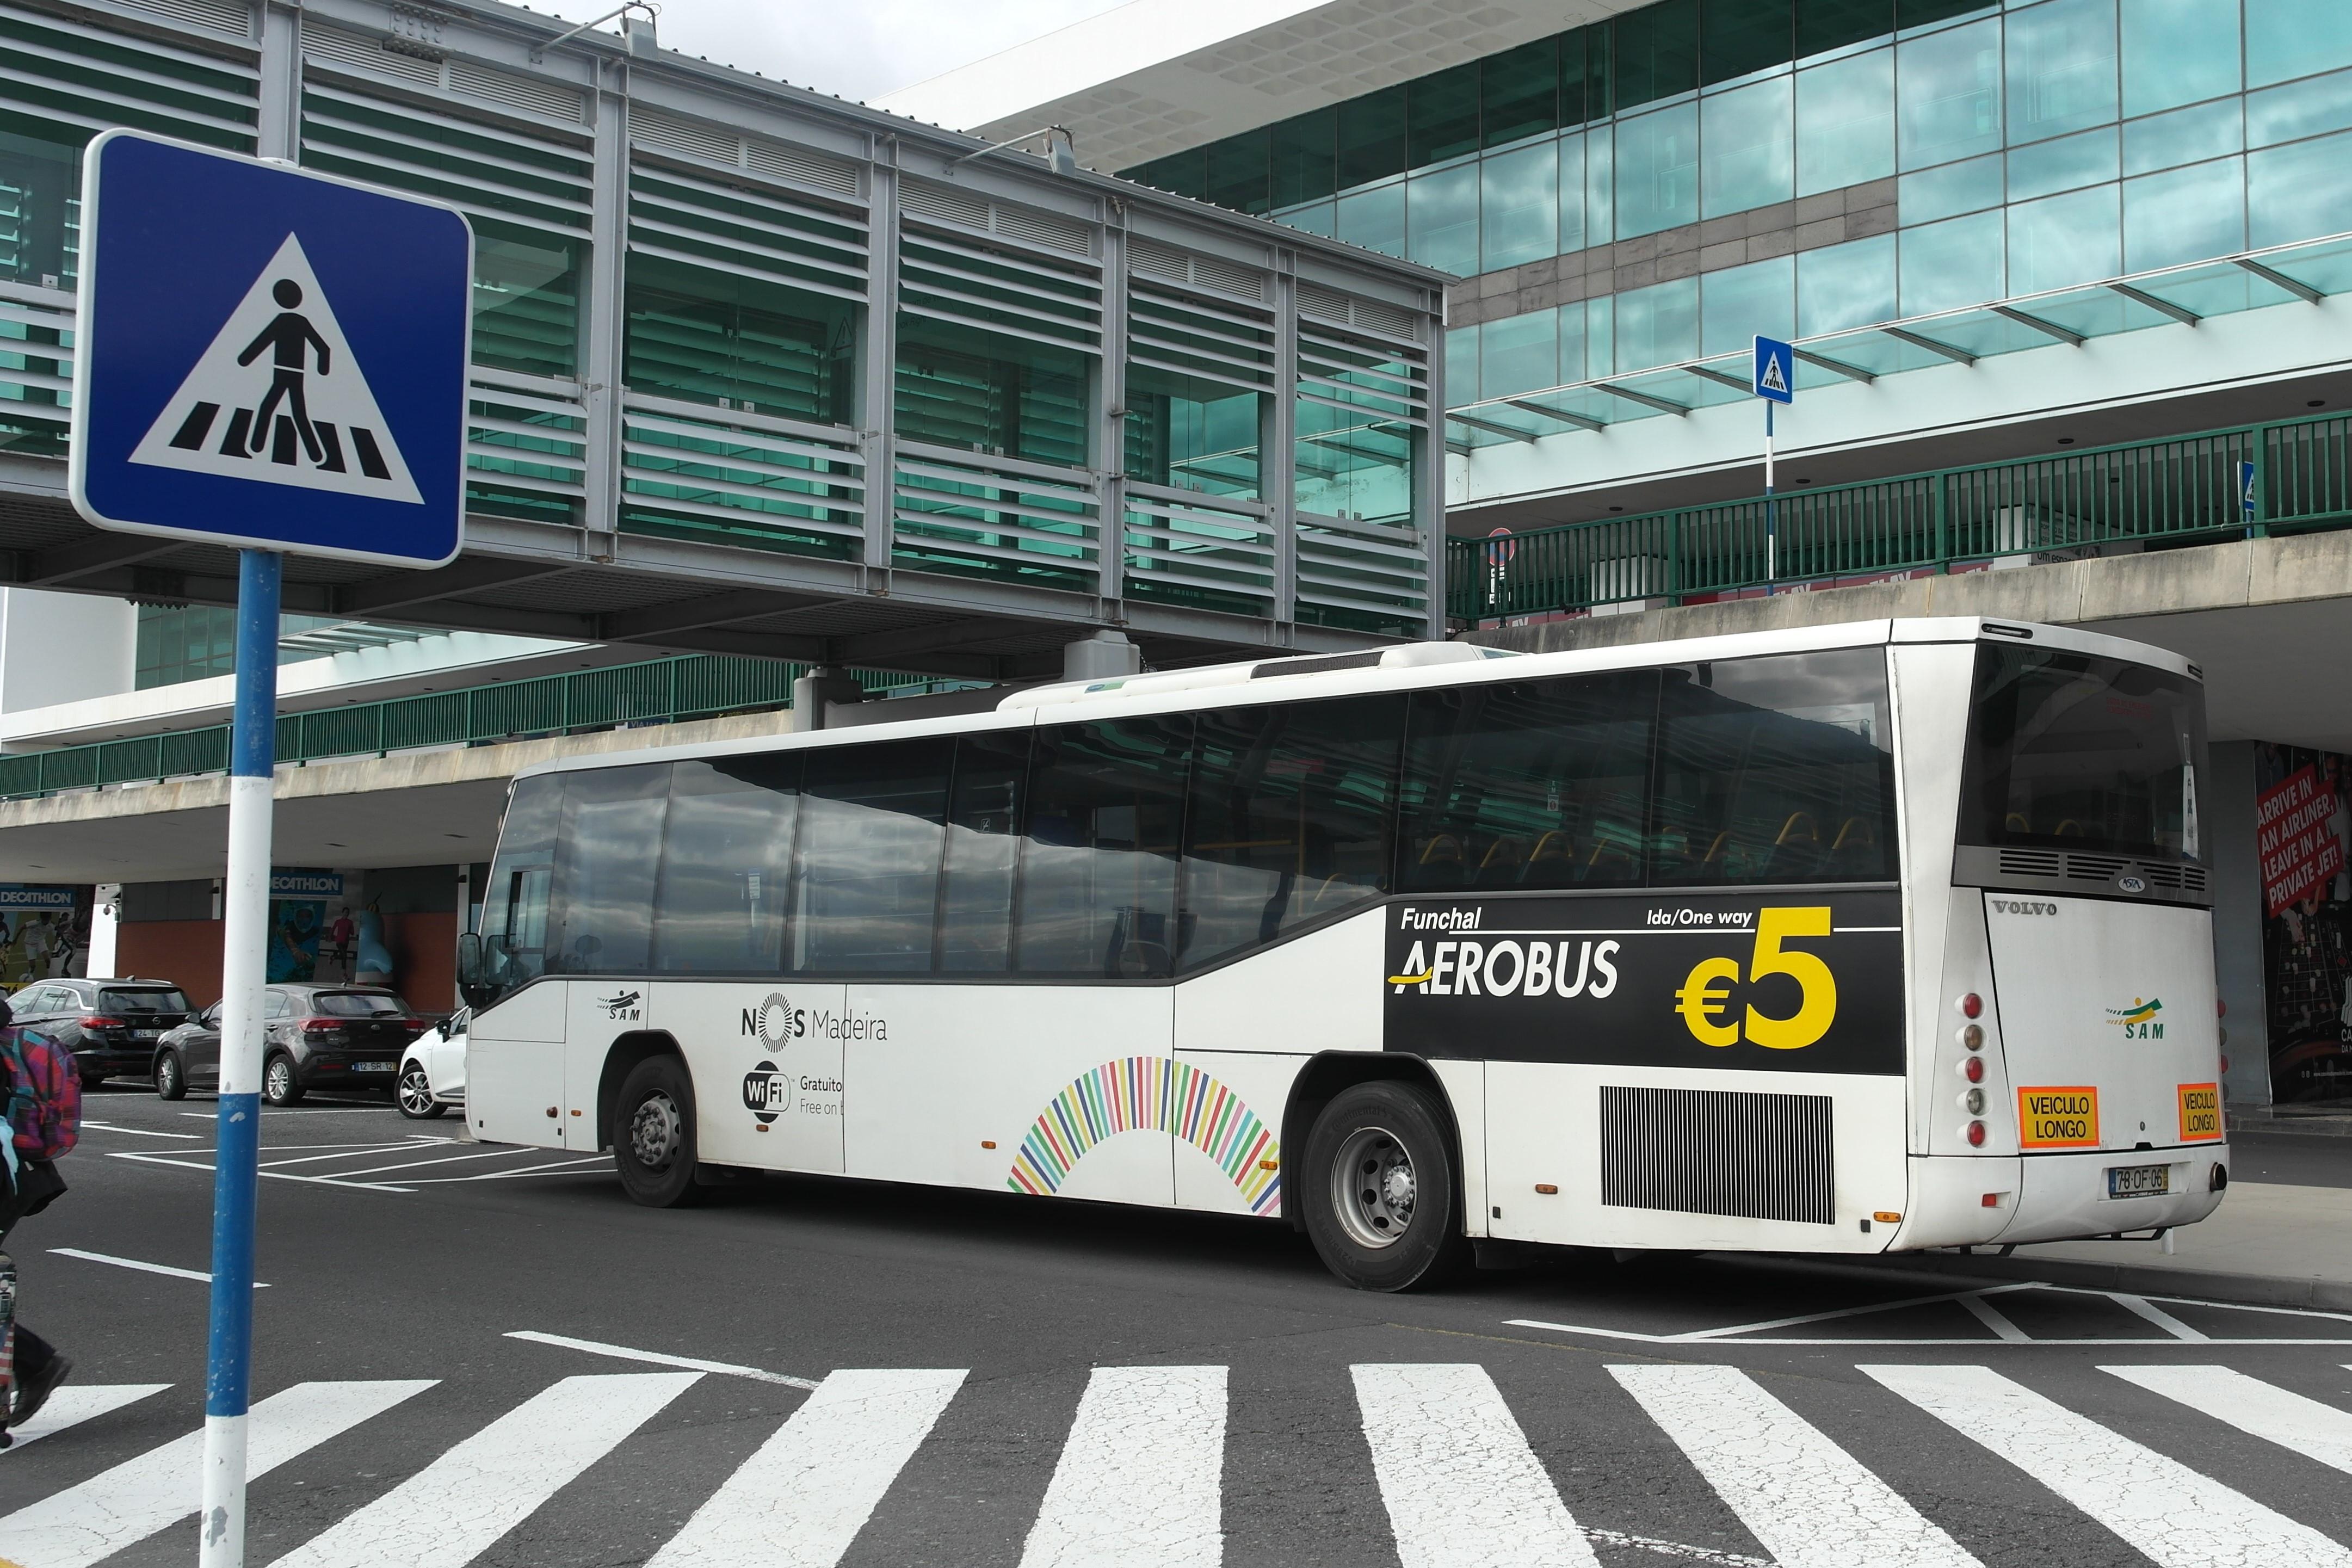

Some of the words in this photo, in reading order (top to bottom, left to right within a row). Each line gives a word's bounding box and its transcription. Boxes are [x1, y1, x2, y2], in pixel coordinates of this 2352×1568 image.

[2257, 785, 2298, 829] ARRIVE
[2300, 775, 2312, 800] IN
[2262, 826, 2279, 856] AN
[2282, 793, 2334, 843] AIRLINER,
[2264, 842, 2299, 882] LEAVE
[2300, 833, 2313, 857] IN
[2317, 826, 2325, 848] A
[270, 876, 338, 891] ECATHLON
[2268, 861, 2314, 909] PRIVATE
[2317, 844, 2338, 876] JET!
[1, 892, 71, 903] DECATHLON
[1992, 900, 2057, 916] VOLVO
[1400, 906, 1482, 930] Funchal
[1647, 909, 1713, 926] Ida/One
[1718, 912, 1752, 927] way
[1393, 940, 1620, 998] AEROBUS
[1675, 906, 1837, 1050] €5
[742, 992, 805, 1053] NOS
[812, 1009, 887, 1041] Madeira
[800, 1076, 842, 1092] Gratuito
[800, 1098, 821, 1114] Free
[824, 1104, 837, 1115] on
[2029, 1096, 2089, 1115] VEICULO
[2184, 1093, 2215, 1110] VEICULO
[2035, 1120, 2086, 1138] LONGO
[2188, 1114, 2215, 1132] LONGO
